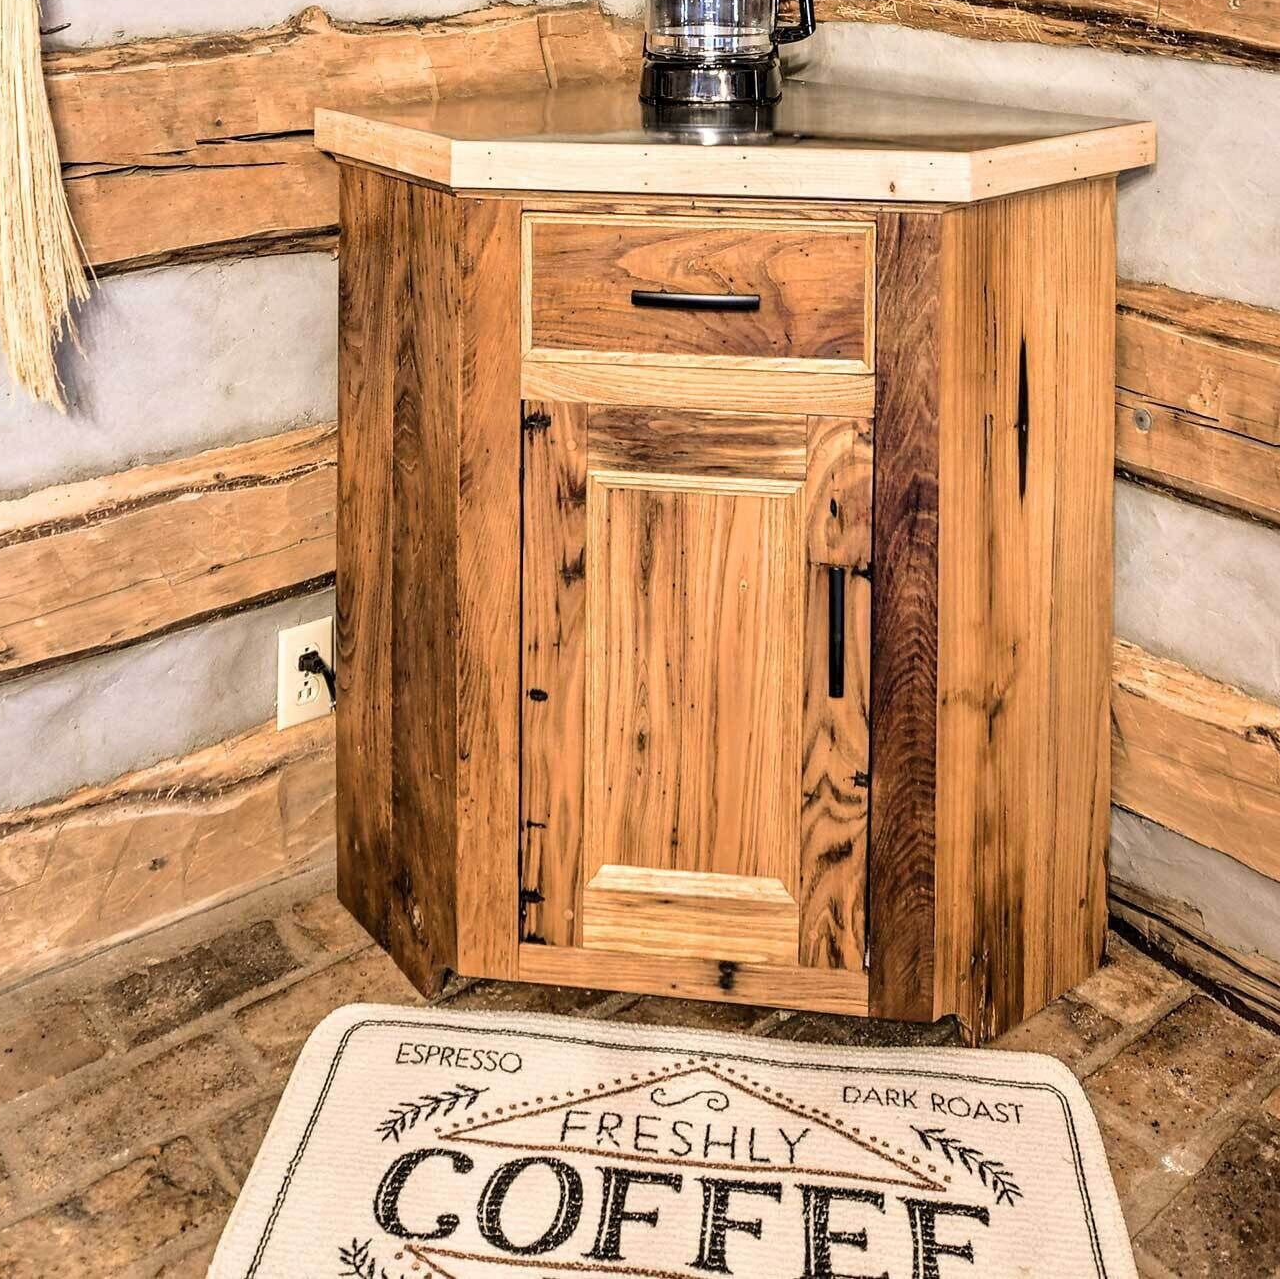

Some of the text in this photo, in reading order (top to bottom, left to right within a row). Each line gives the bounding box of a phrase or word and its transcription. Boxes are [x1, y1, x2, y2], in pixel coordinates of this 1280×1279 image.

[395, 1042, 523, 1073] ESPRESSO
[842, 1086, 1024, 1123] DARK ROAST
[560, 1109, 811, 1164] FRESHLY
[372, 1147, 991, 1279] COFFEE
